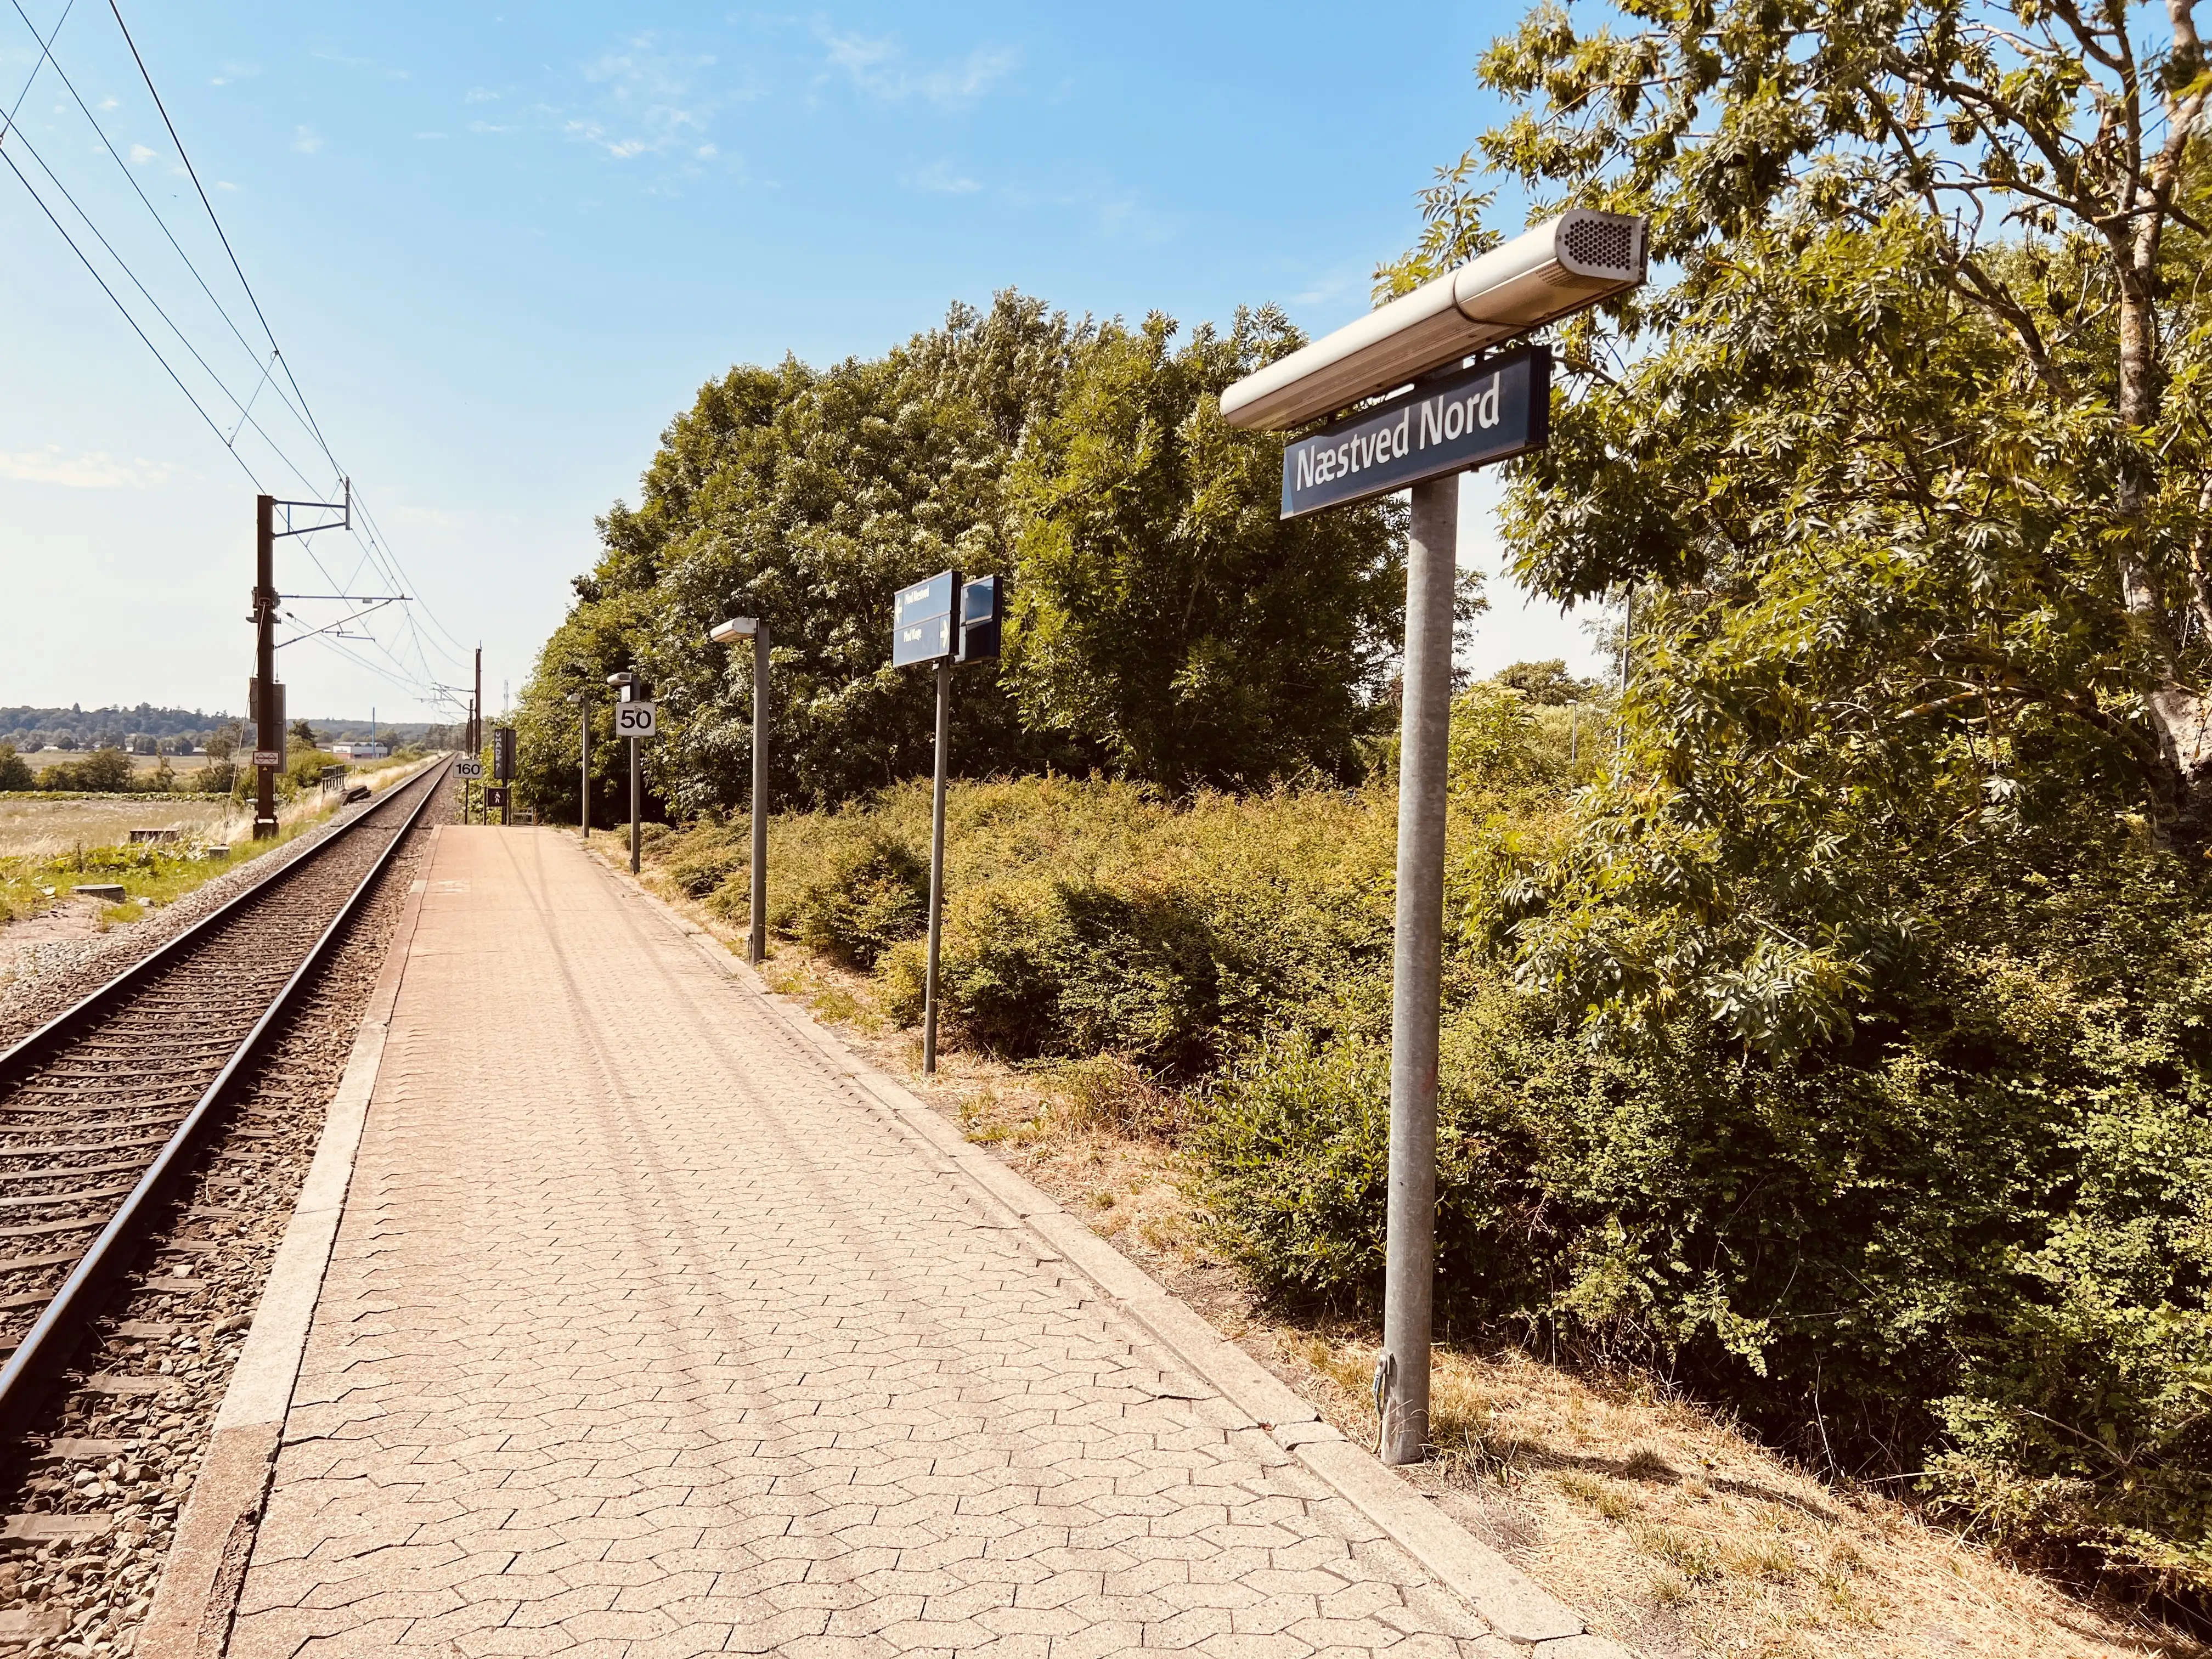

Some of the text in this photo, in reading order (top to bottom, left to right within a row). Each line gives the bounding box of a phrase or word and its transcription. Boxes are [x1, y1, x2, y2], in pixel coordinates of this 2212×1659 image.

[1296, 371, 1500, 492] Næstved Nord
[620, 710, 652, 729] 50
[456, 763, 481, 775] 160
